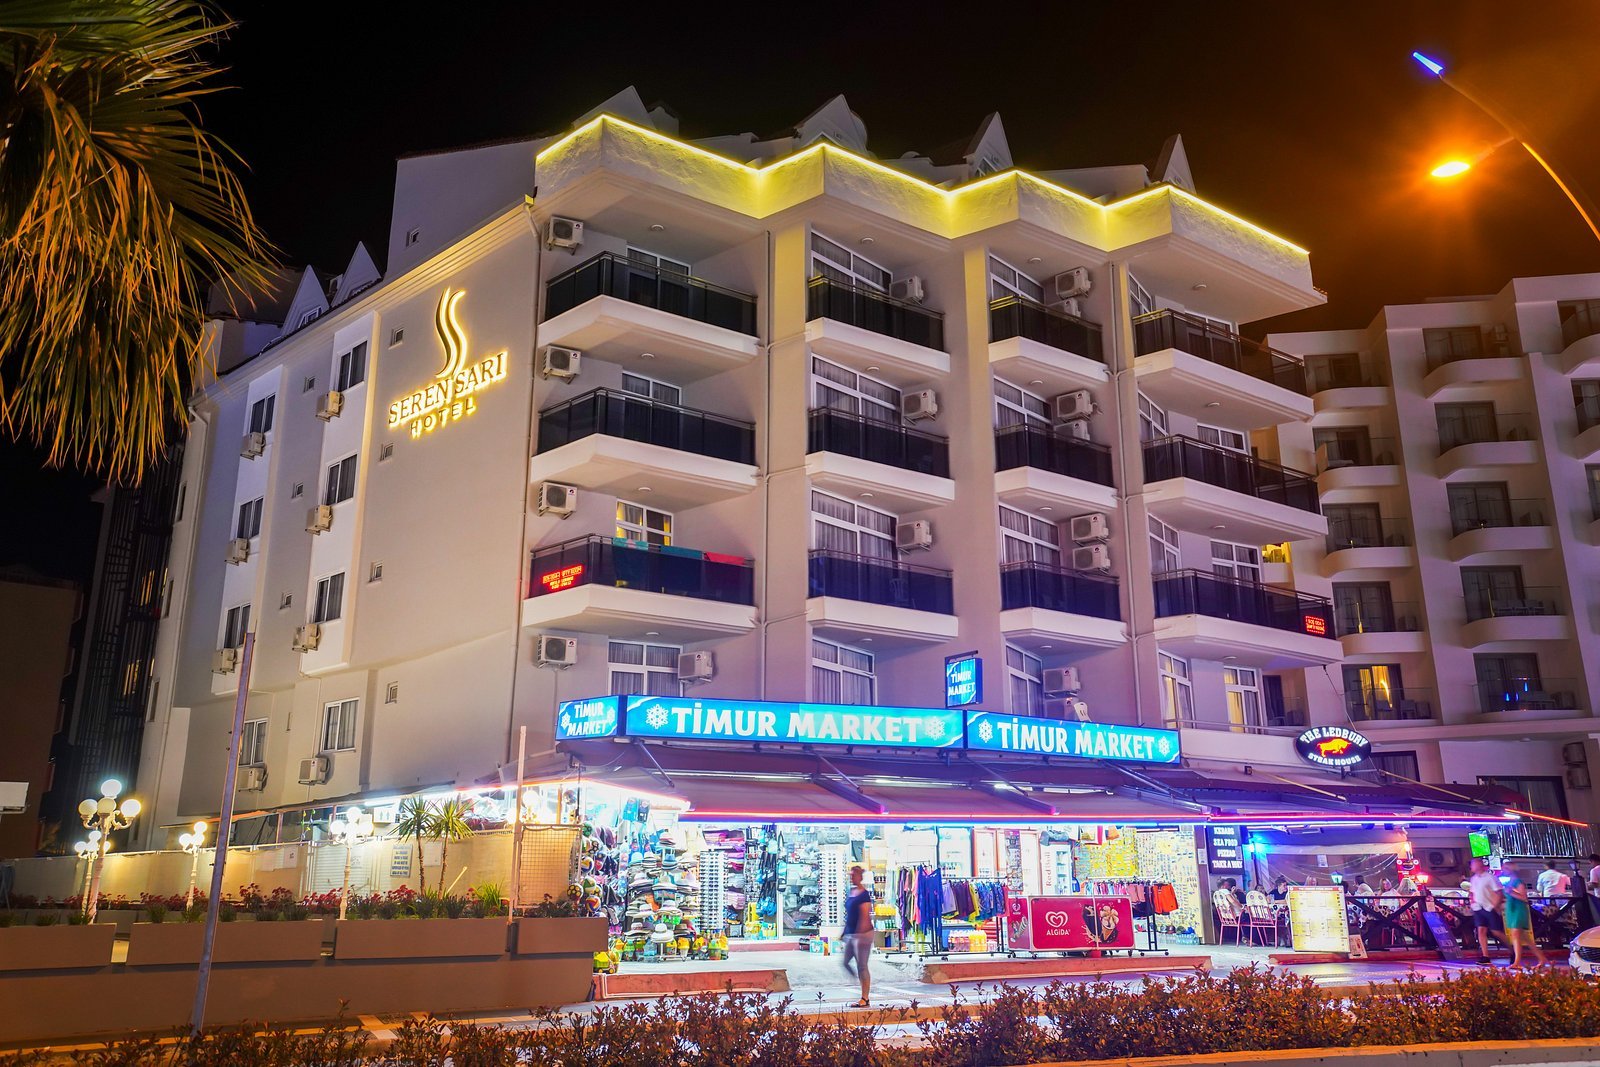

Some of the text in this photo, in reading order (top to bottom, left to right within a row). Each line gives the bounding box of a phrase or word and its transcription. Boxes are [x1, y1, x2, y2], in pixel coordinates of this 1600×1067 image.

[388, 350, 509, 427] SEREN SARI
[410, 398, 476, 437] HOTEL
[948, 682, 976, 696] MARKET
[574, 701, 604, 719] TİMUR
[566, 719, 607, 737] MARKET
[671, 702, 923, 743] TİMUR MARKET
[997, 718, 1156, 760] TİMUR MARKET
[1299, 726, 1369, 747] THE LEDBURY
[1307, 752, 1362, 766] STEAK HOUSE
